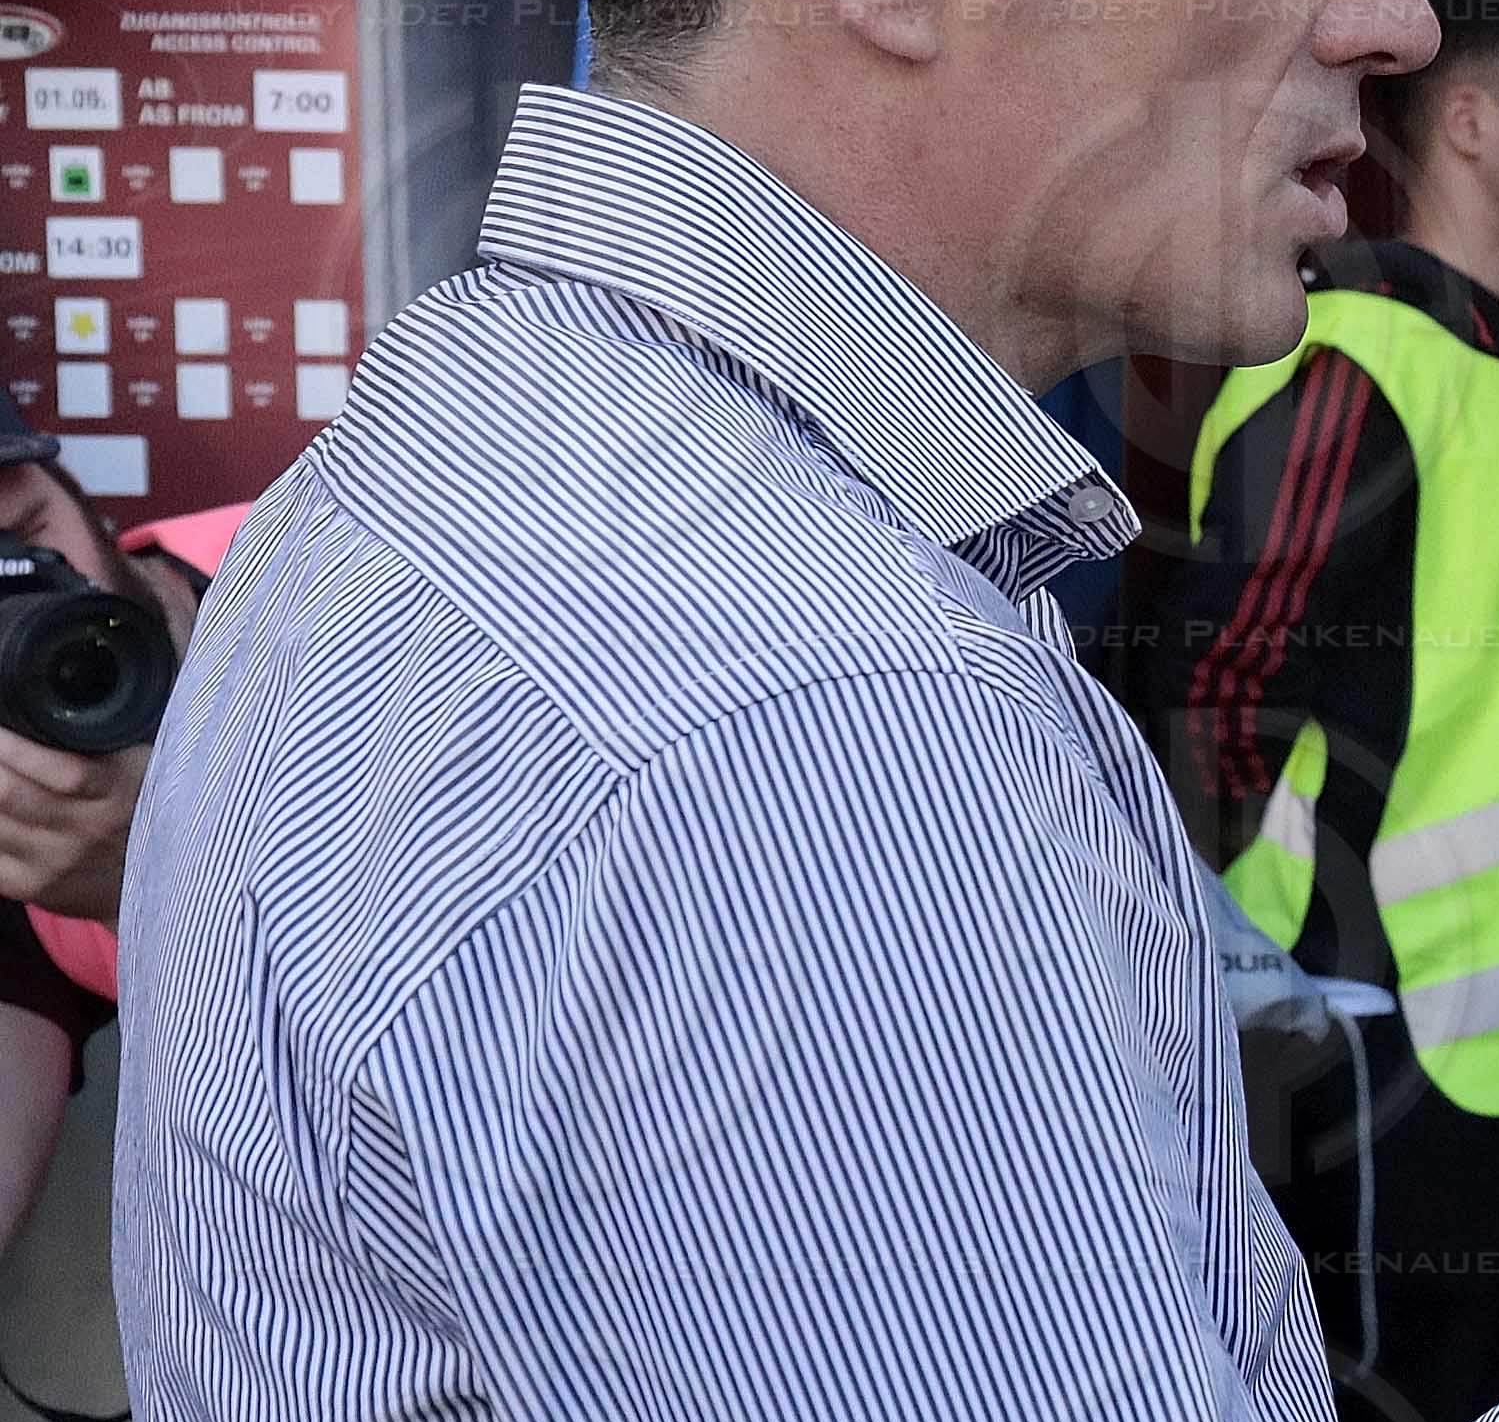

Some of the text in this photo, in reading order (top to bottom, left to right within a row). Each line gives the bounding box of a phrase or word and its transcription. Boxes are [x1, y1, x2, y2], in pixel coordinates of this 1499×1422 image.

[151, 33, 228, 52] ACCESS
[270, 90, 332, 114] 7:00
[176, 103, 246, 127] FROM
[53, 236, 132, 259] 14:30
